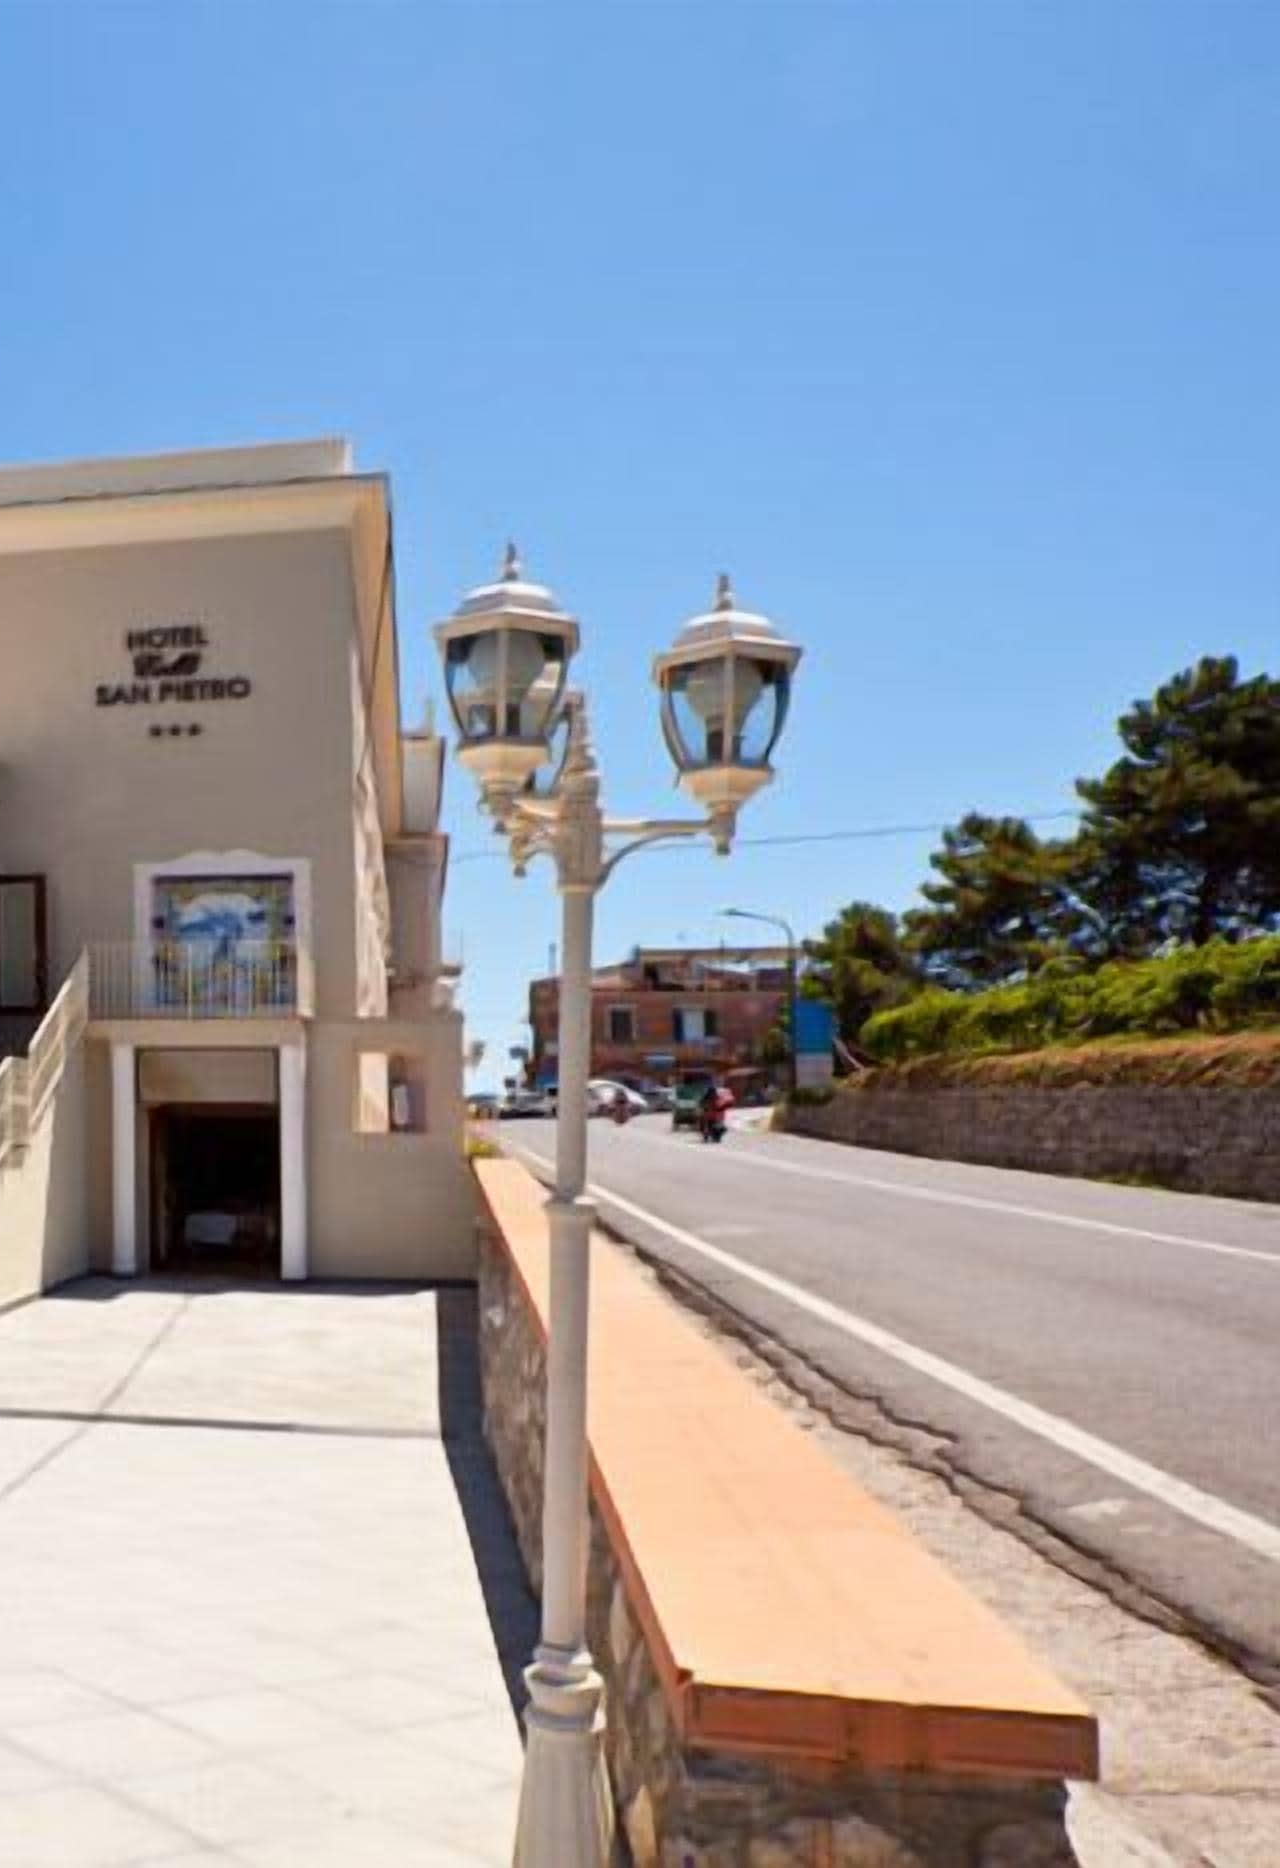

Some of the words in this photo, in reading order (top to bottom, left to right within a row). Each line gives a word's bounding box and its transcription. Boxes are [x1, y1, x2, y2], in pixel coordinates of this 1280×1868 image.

[127, 626, 207, 650] HOTEL
[96, 684, 150, 706] SAN
[159, 678, 251, 703] PIETRO
